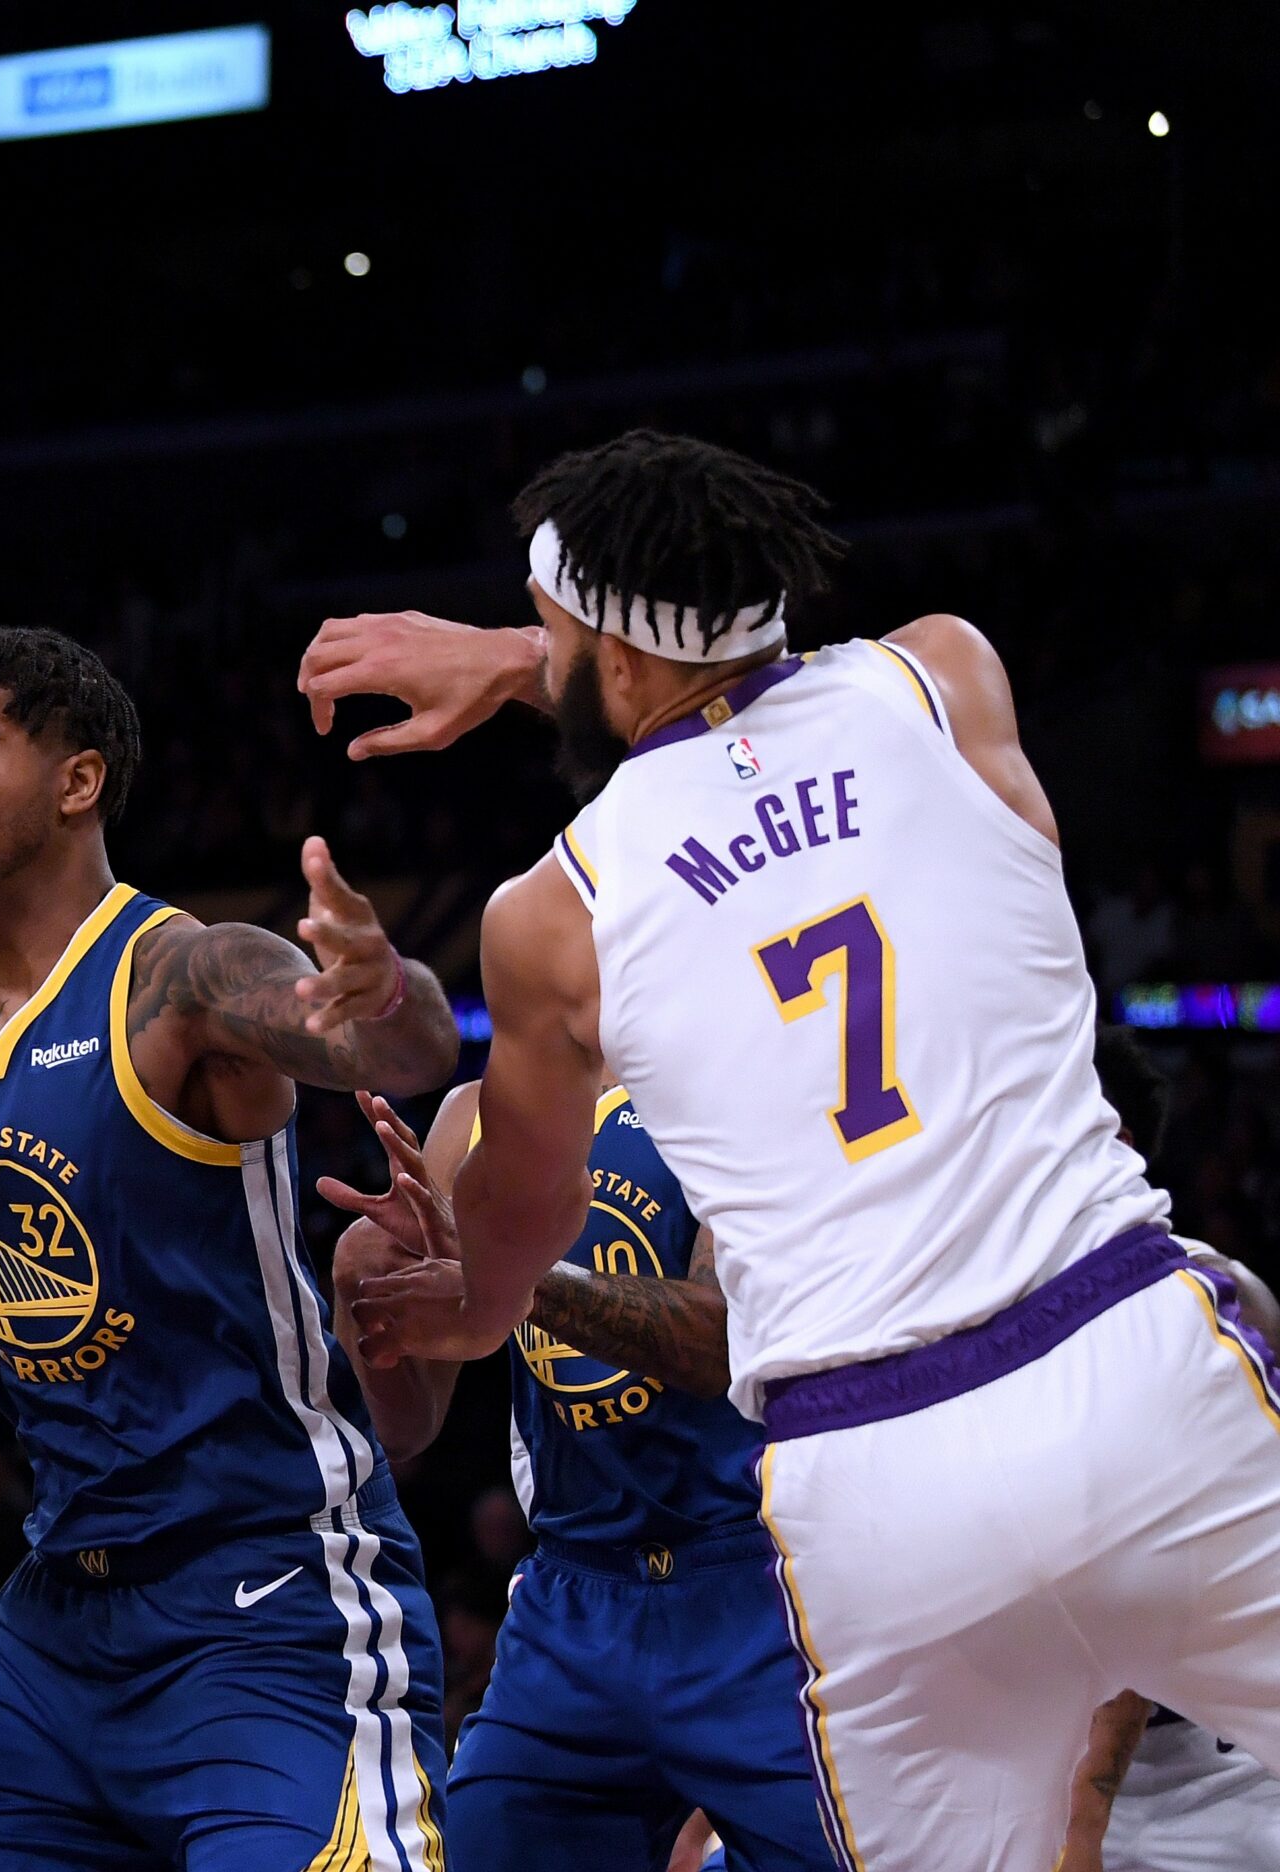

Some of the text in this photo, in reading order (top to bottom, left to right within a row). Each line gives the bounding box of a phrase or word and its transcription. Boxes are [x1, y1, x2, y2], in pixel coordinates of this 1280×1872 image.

[665, 769, 860, 906] McGEE
[31, 1037, 99, 1069] Rakuten
[749, 892, 924, 1165] 7
[0, 1127, 79, 1185] STATE
[592, 1168, 661, 1222] STATE
[8, 1203, 75, 1258] 32
